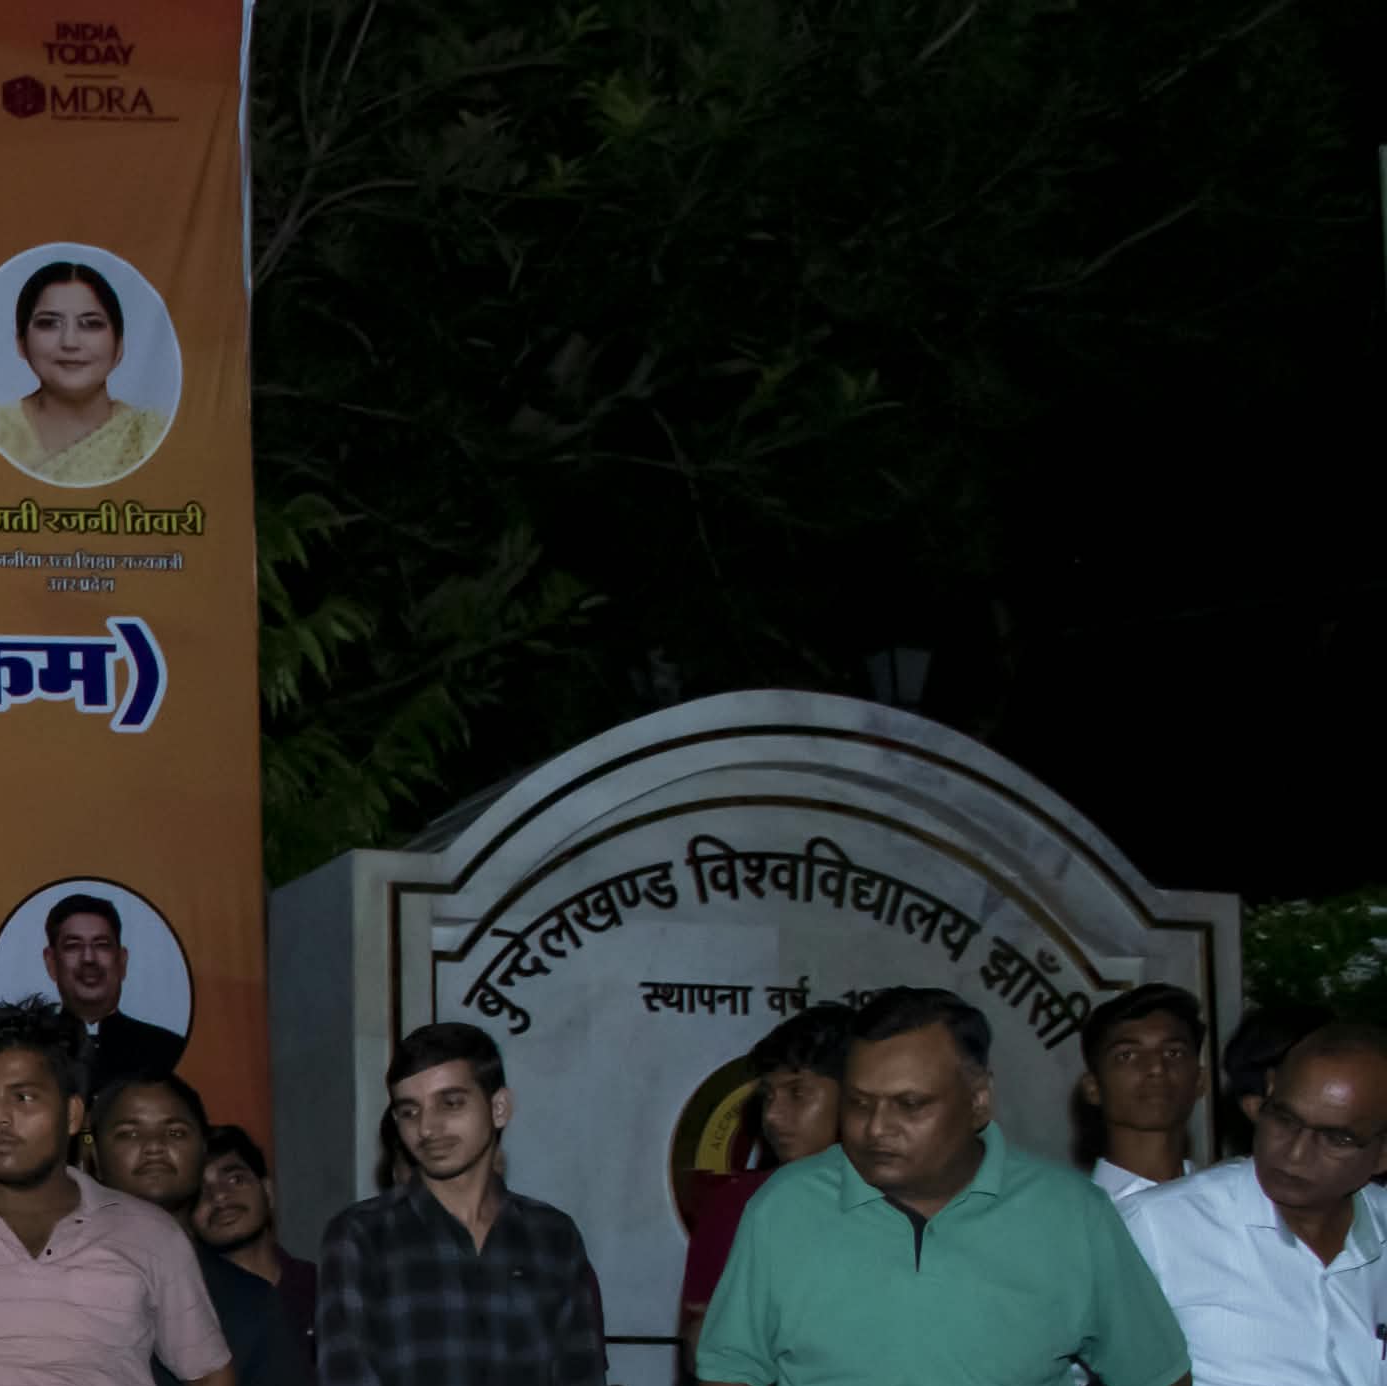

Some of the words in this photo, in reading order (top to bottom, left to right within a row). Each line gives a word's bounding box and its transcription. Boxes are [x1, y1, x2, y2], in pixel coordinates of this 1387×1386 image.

[55, 23, 122, 41] INDIA
[43, 42, 136, 65] TODAY
[50, 86, 154, 114] MDRA
[43, 500, 120, 534] रजनी
[123, 500, 205, 535] तिवारी
[462, 860, 678, 1036] बुन्देलखण्ड
[684, 834, 984, 964] विश्वविद्यालय
[978, 934, 1092, 1051] झाँसी
[639, 981, 753, 1016] स्थापना
[764, 976, 811, 1016] वर्ष
